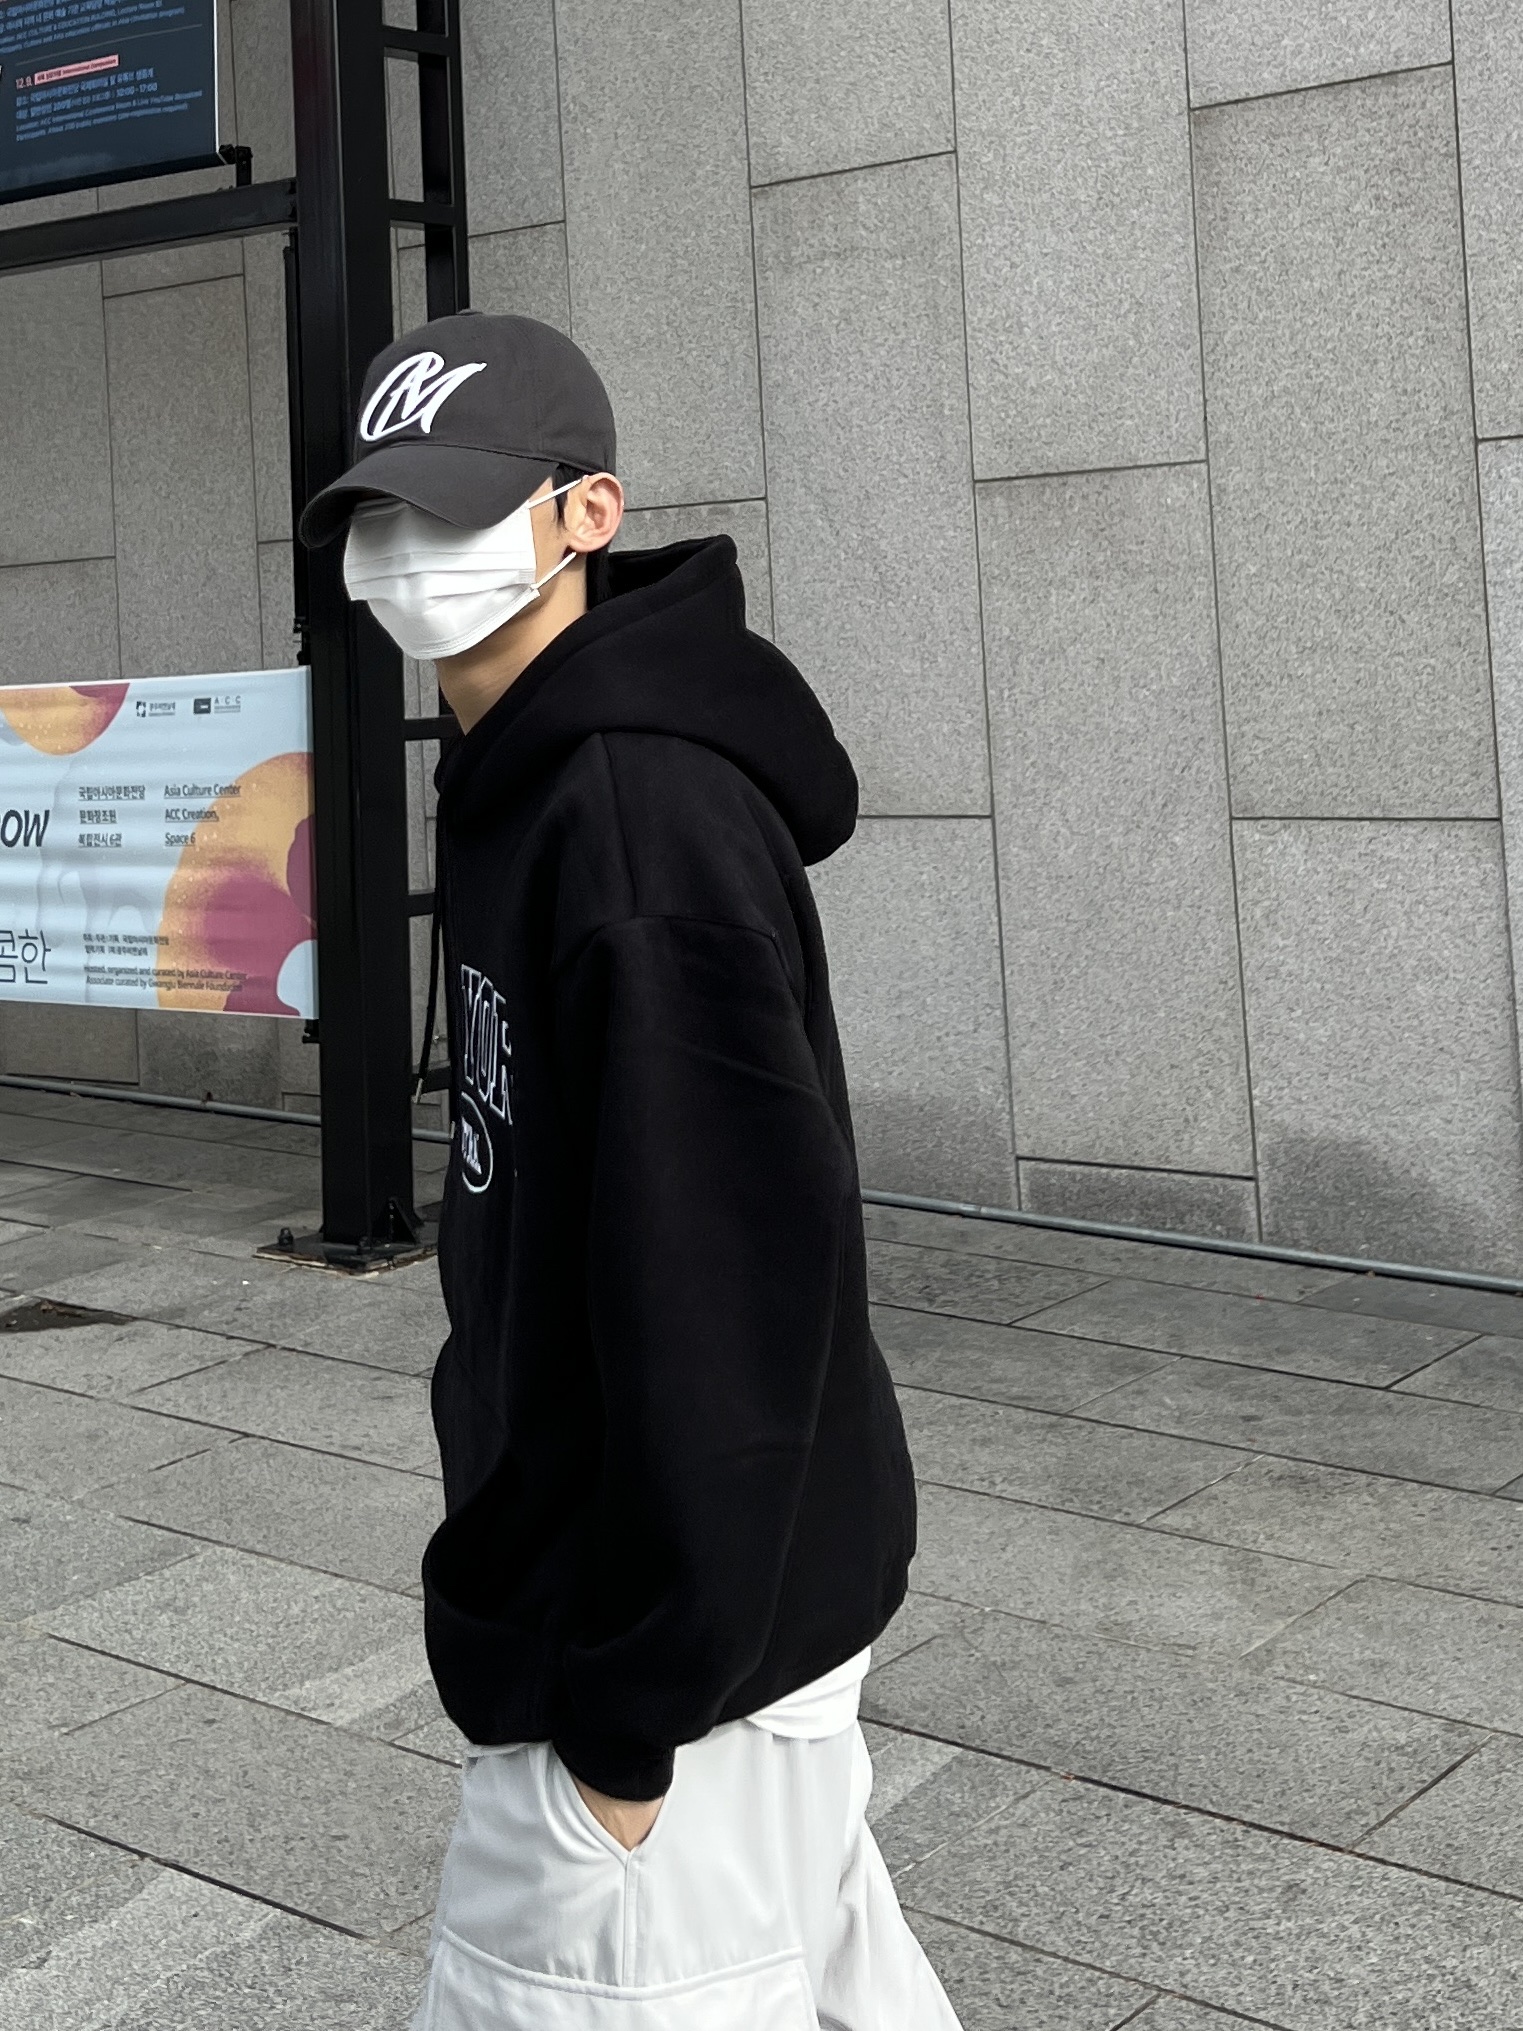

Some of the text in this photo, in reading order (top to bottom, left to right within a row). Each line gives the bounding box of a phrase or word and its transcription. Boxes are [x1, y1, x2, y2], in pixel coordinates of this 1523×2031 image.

[164, 783, 241, 796] Asia Culture Center
[165, 808, 180, 820] ACC
[165, 832, 196, 846] Space 6
